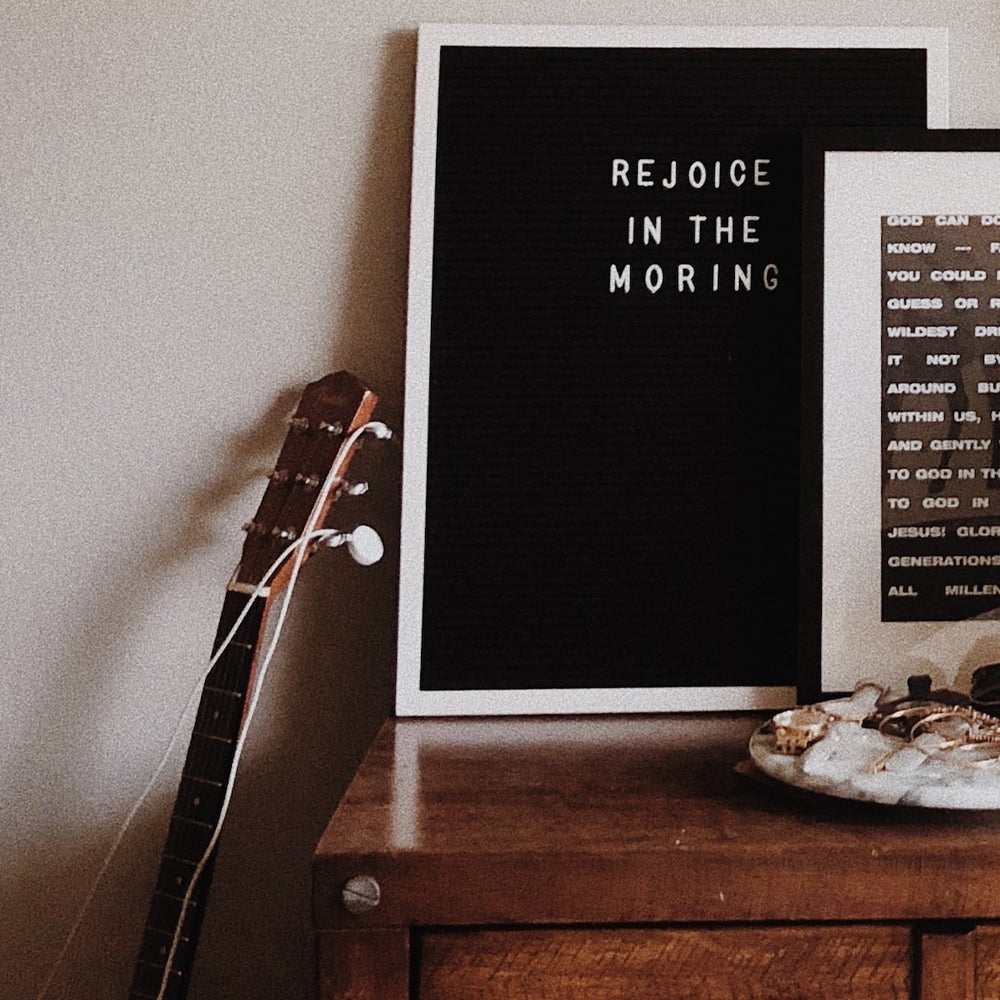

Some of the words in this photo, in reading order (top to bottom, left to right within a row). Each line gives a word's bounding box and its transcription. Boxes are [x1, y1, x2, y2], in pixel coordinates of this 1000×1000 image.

[612, 158, 771, 189] REJOICE
[887, 214, 923, 227] GOD
[935, 214, 969, 227] CAN
[628, 215, 662, 245] IN
[688, 215, 760, 245] THE
[888, 242, 937, 254] KNOW
[609, 263, 779, 294] MORING
[888, 270, 921, 282] YOU
[931, 270, 987, 282] COULD
[887, 298, 944, 310] GUESS
[955, 297, 979, 309] OR
[888, 326, 958, 338] WILDEST
[888, 354, 903, 366] IT
[927, 354, 961, 366] NOT
[887, 382, 957, 395] AROUND
[888, 411, 944, 423] WITHIN
[954, 410, 982, 424] US,
[887, 440, 923, 452] AND
[931, 439, 992, 451] GENTLY
[888, 468, 910, 481] TO
[916, 468, 952, 480] GOD
[958, 468, 976, 479] IN
[888, 497, 910, 509] TO
[923, 497, 960, 509] GOD
[973, 497, 989, 508] IN
[888, 526, 947, 538] JESUS!
[888, 585, 918, 597] ALL
